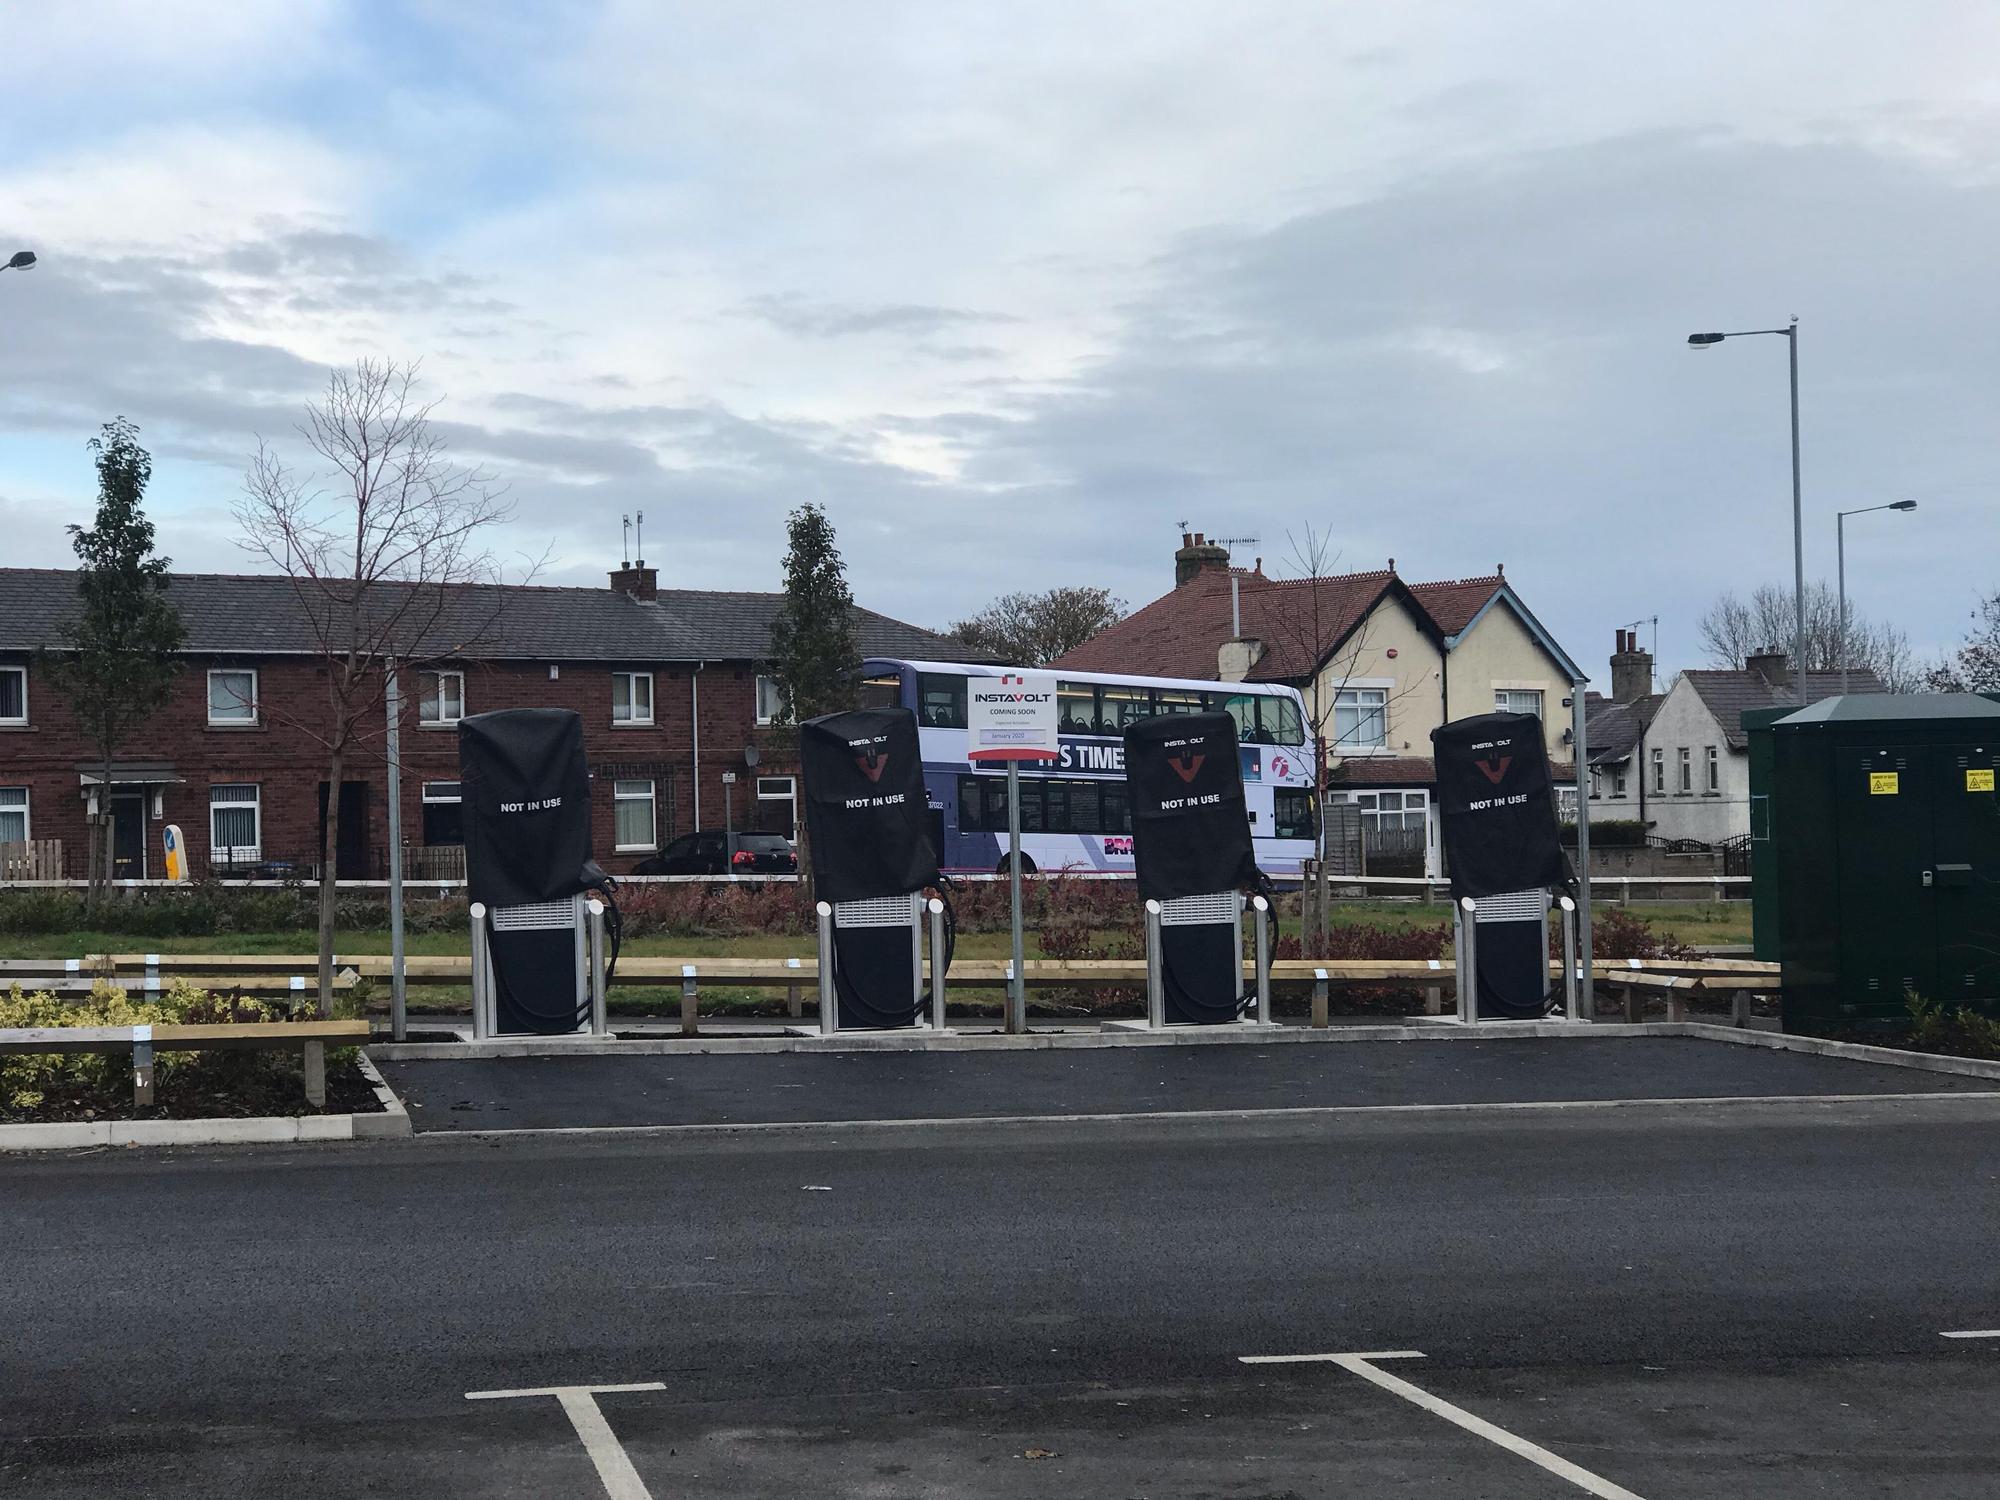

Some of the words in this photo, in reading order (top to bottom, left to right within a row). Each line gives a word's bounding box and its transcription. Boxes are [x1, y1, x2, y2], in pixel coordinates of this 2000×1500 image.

[975, 694, 1051, 702] INSTAVOLT
[848, 735, 888, 747] INSTAOLT
[1164, 737, 1204, 748] INSTAOLT
[1471, 739, 1511, 750] INSTAOLT
[1075, 745, 1126, 770] TIME
[500, 803, 524, 812] NOT
[527, 801, 540, 811] IN
[543, 797, 561, 809] USE
[846, 799, 869, 809] NOT
[872, 797, 883, 807] IN
[885, 794, 905, 804] USE
[1161, 799, 1184, 810] NOT
[1187, 798, 1198, 807] IN
[1200, 794, 1220, 804] USE
[1470, 800, 1492, 811] NOT
[1494, 798, 1505, 807] IN
[1507, 794, 1528, 804] USE
